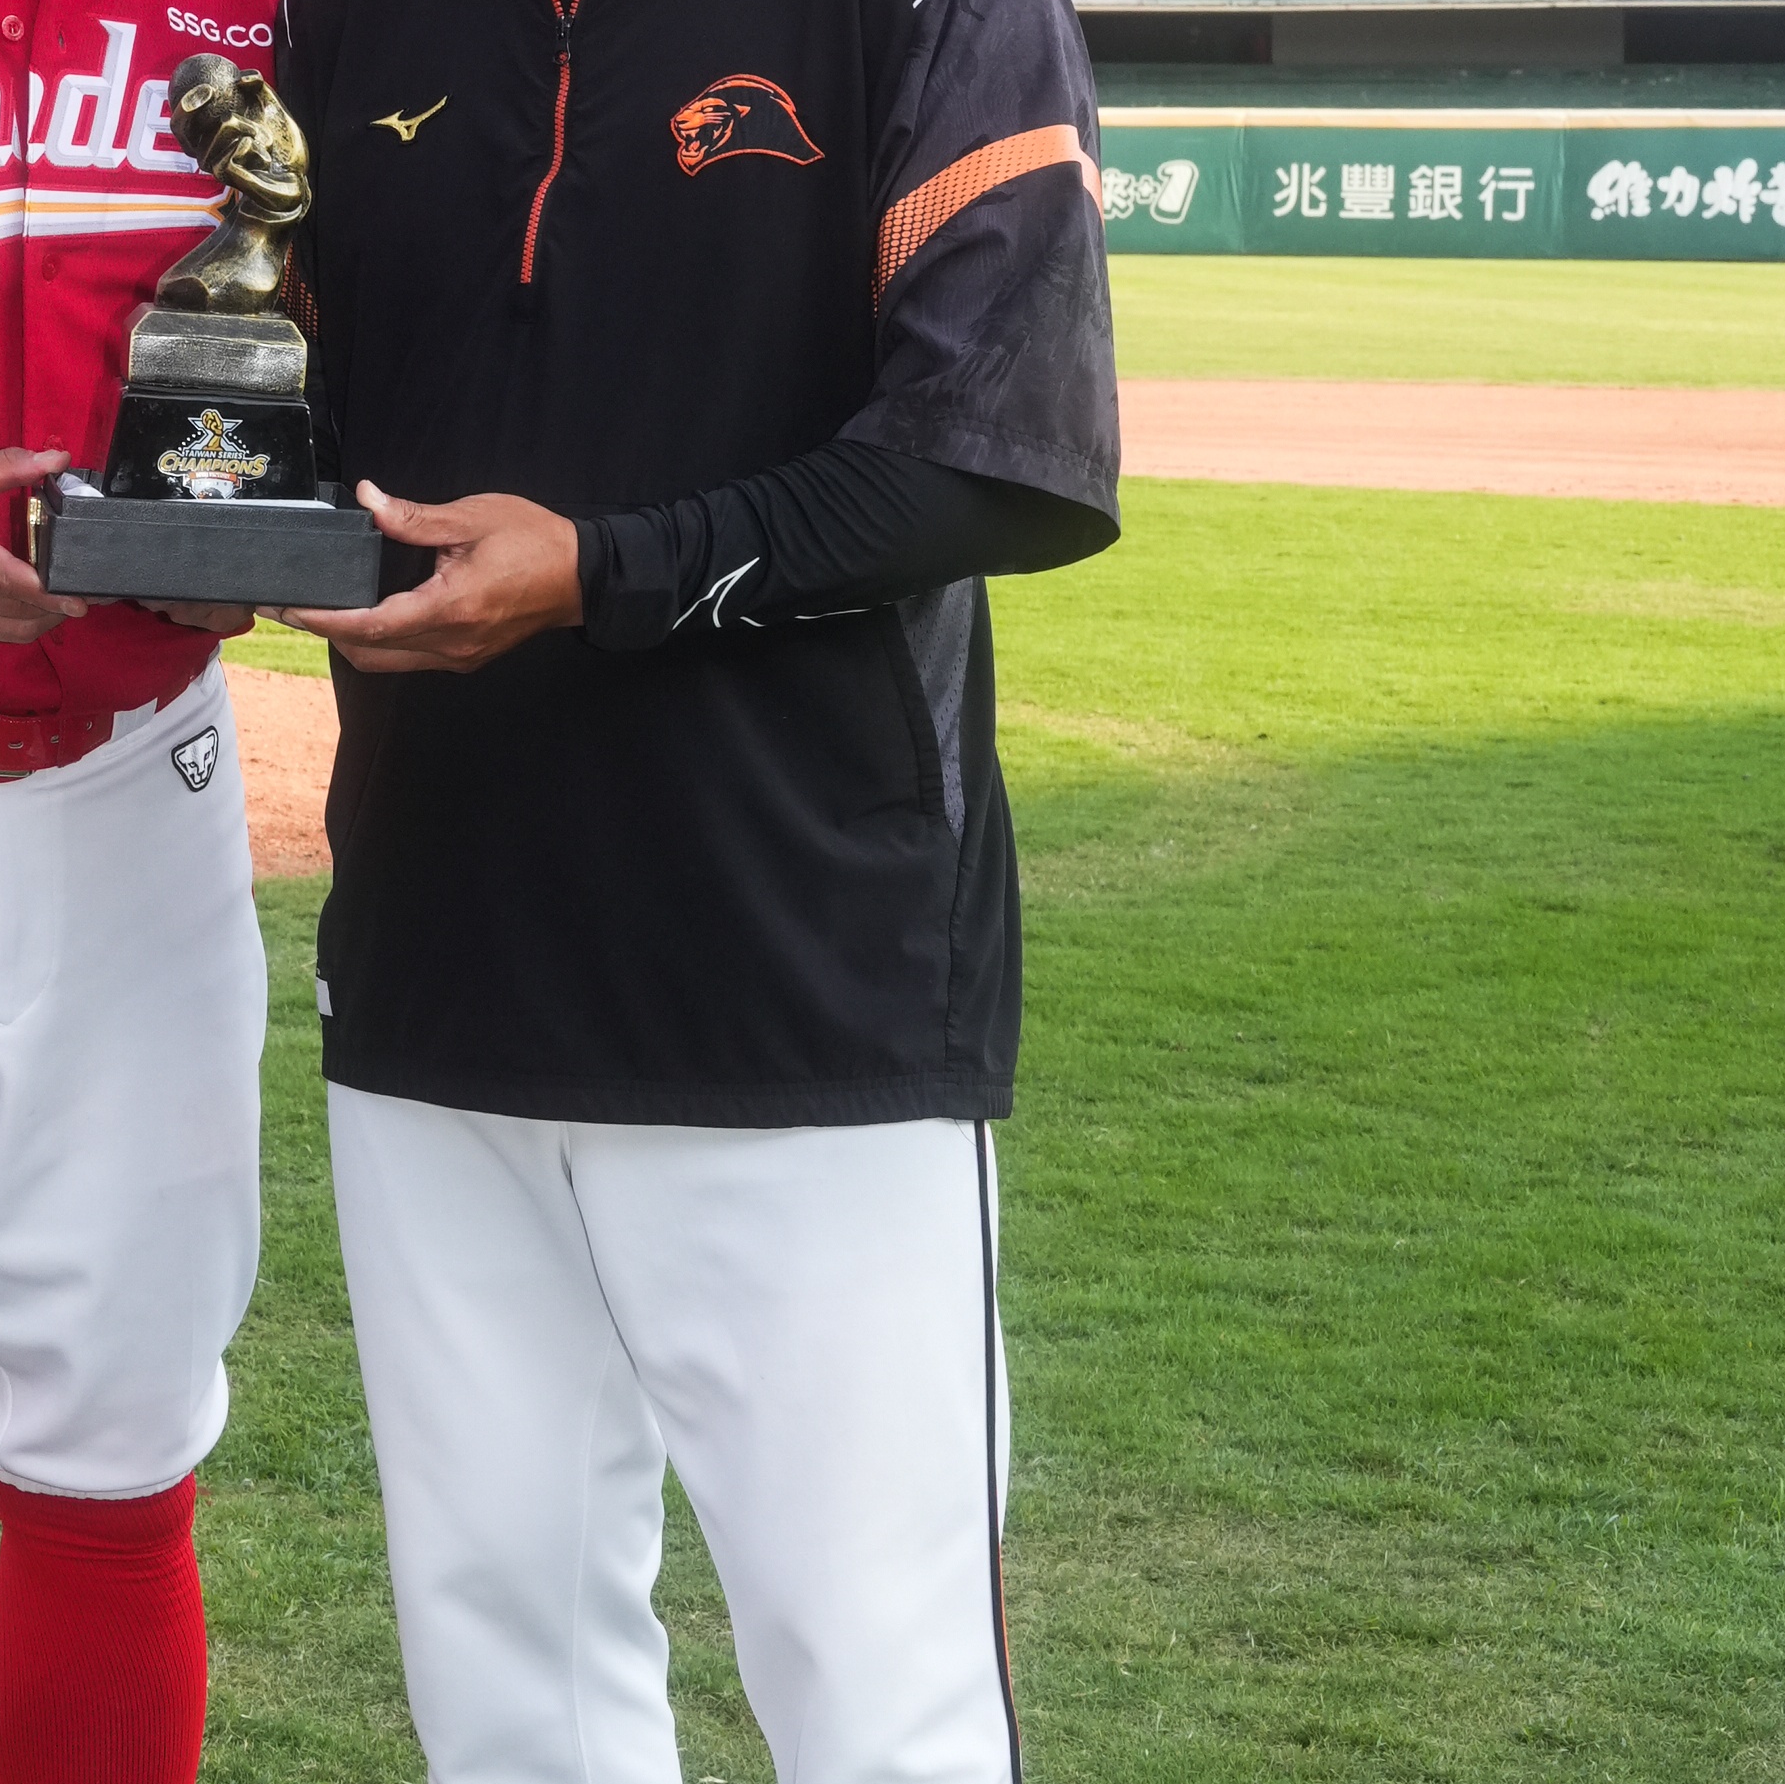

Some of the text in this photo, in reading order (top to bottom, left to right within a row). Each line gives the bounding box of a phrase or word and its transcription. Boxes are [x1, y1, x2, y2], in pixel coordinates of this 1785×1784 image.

[167, 6, 274, 48] SSG.CO
[1272, 162, 1536, 221] 兆豐銀行
[159, 452, 268, 477] CHAMPIONS
[183, 450, 244, 460] TAIWAN SERIES
